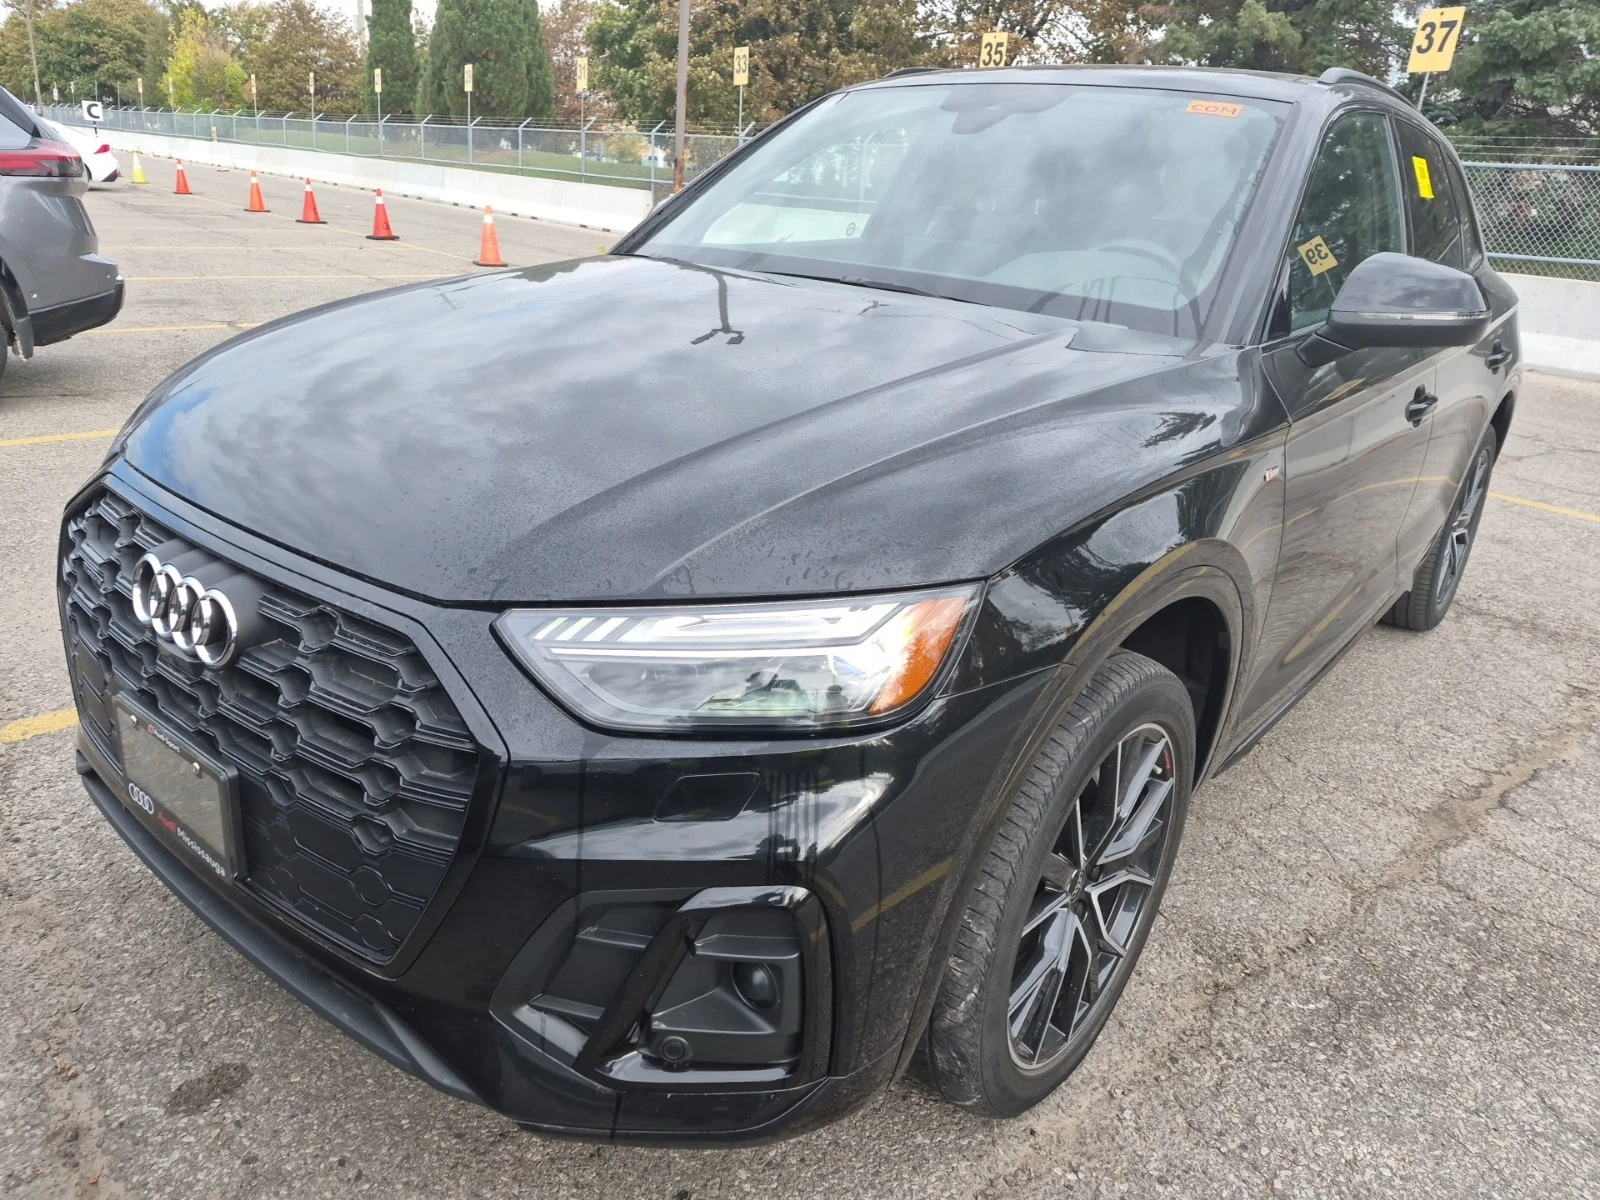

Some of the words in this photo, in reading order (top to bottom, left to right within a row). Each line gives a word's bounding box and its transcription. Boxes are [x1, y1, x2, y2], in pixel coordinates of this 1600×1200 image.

[1416, 20, 1458, 54] 37
[735, 54, 747, 74] 33
[982, 42, 1004, 66] 35
[578, 63, 586, 80] 31
[86, 103, 100, 119] C
[1191, 104, 1238, 115] COM
[157, 811, 177, 834] Audi
[177, 826, 226, 877] Mississauga
